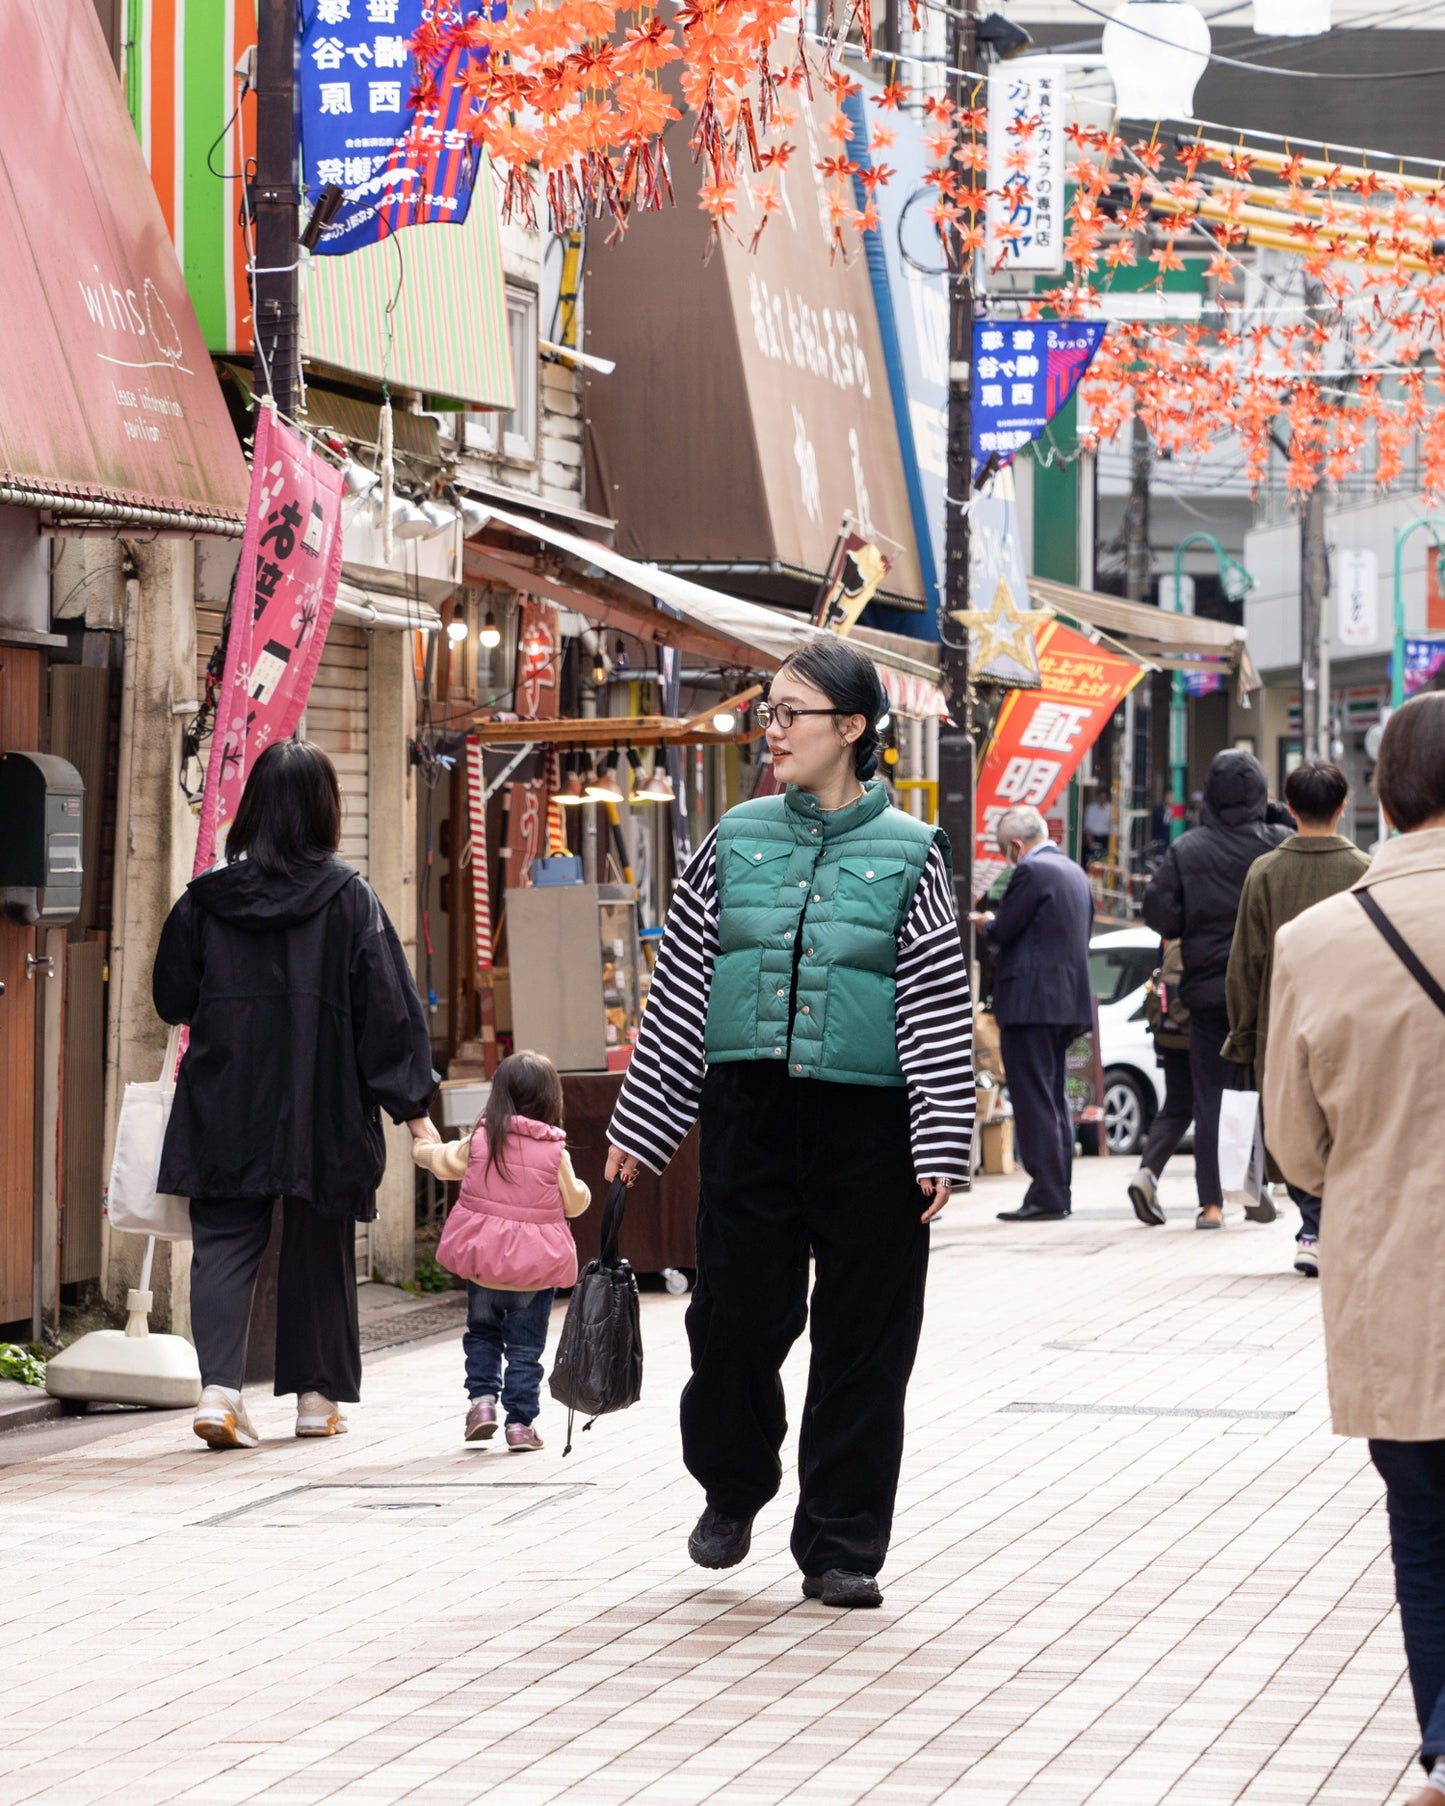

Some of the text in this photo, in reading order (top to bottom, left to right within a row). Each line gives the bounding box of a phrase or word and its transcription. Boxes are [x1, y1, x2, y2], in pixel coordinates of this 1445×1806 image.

[1002, 80, 1032, 258] カメタカヤ
[1035, 78, 1053, 247] 写真とカメラの専門店
[78, 265, 146, 336] wins
